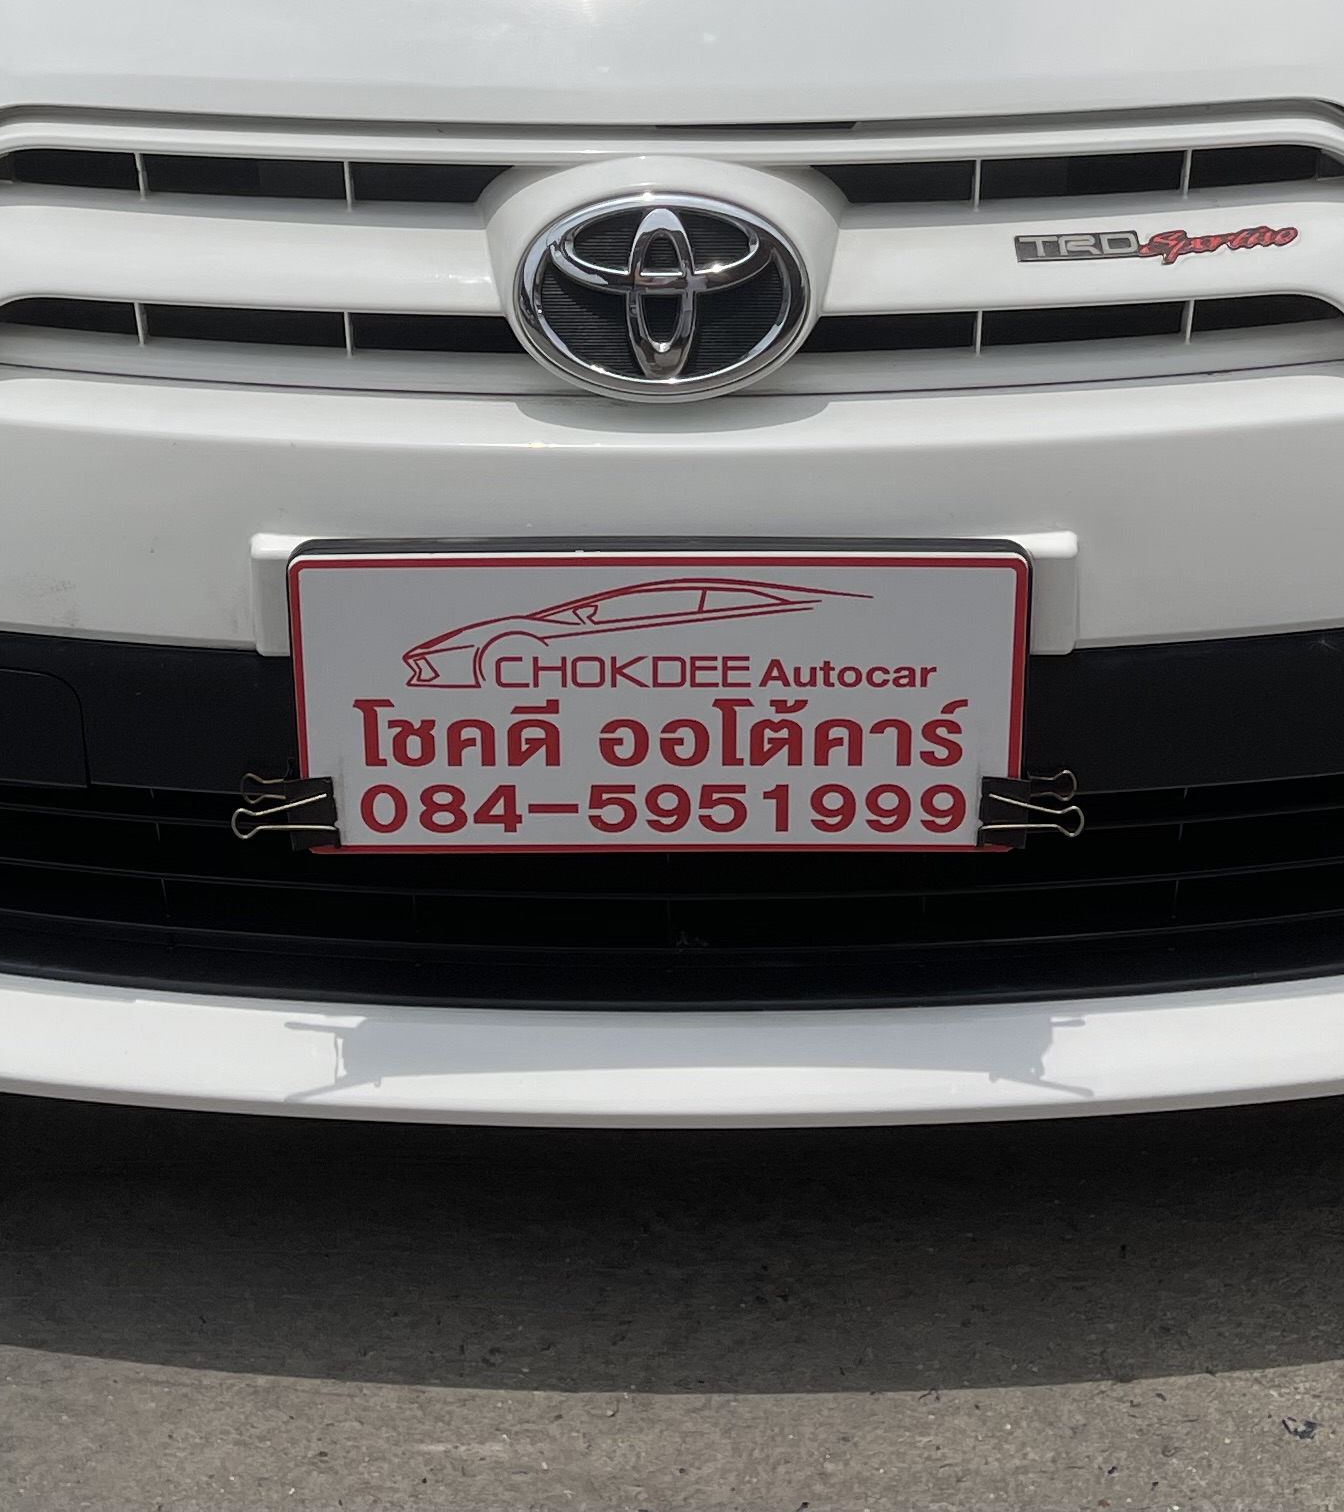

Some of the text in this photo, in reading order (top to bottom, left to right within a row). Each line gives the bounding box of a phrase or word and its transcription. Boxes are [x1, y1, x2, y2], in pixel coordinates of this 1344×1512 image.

[1017, 232, 1140, 257] TRD
[494, 655, 937, 689] CHOKDEE Autocar
[353, 697, 969, 767] โชคดี ออโต้คาร์
[360, 783, 967, 834] 084-5951999
